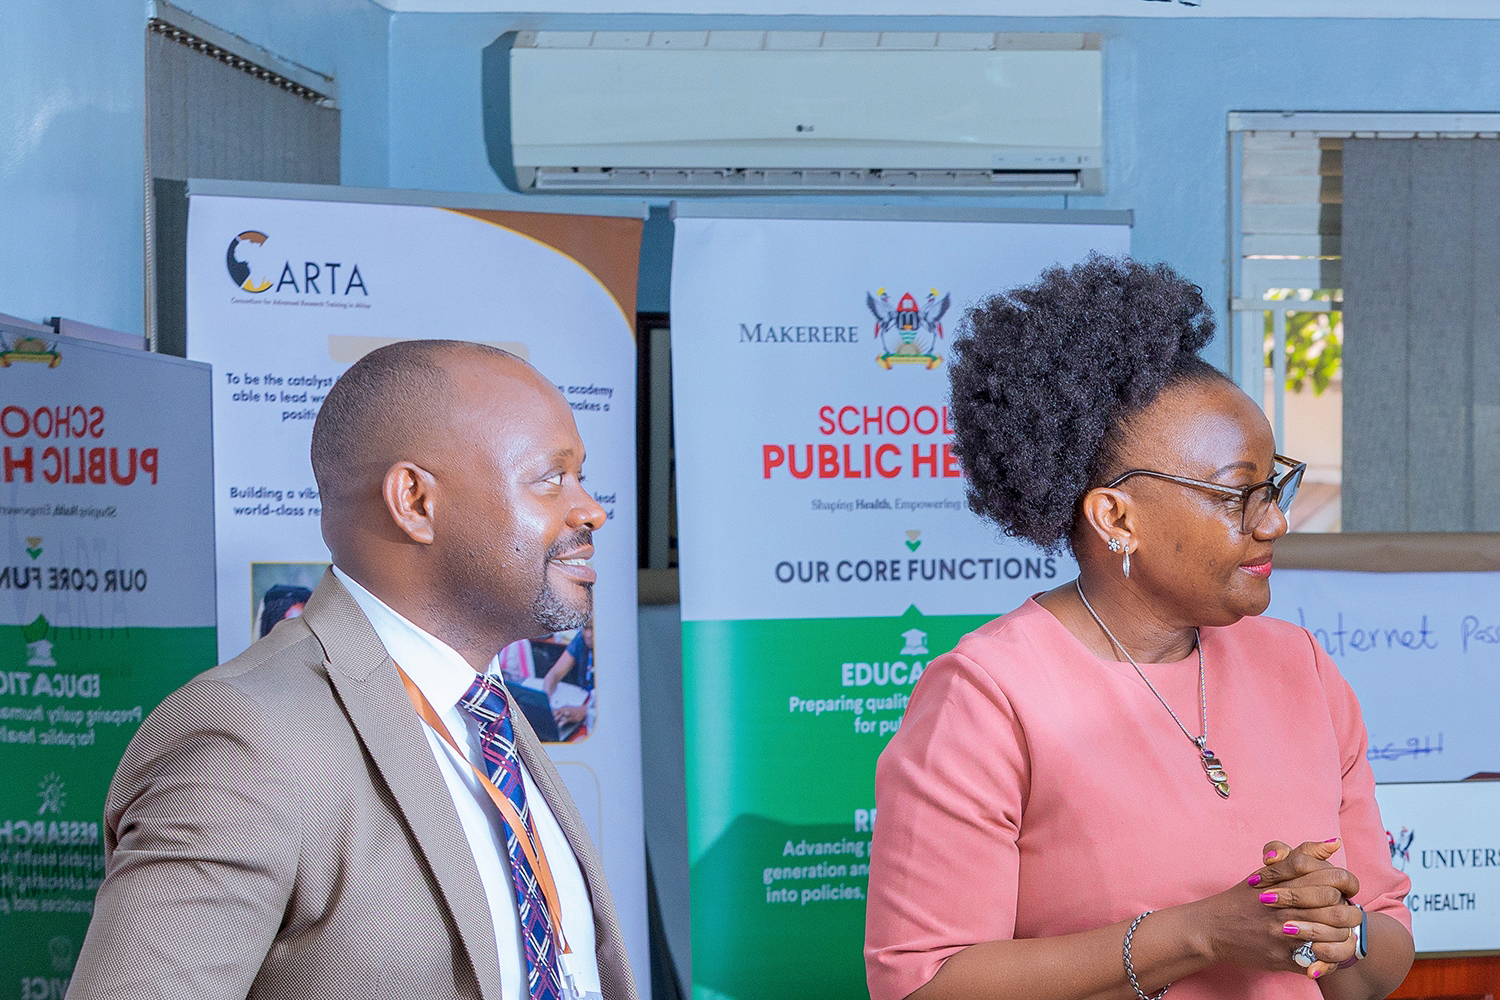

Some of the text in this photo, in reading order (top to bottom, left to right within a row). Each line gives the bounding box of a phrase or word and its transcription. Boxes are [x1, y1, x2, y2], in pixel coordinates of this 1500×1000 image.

[226, 373, 240, 385] To
[244, 373, 260, 385] be
[264, 374, 283, 386] the
[287, 374, 332, 389] catalyst
[568, 383, 614, 399] academy
[232, 390, 260, 402] able
[265, 391, 276, 402] to
[280, 391, 307, 402] lead
[819, 406, 955, 435] SCHOOL
[763, 443, 968, 479] PUBLIC HE
[230, 487, 283, 501] Building
[287, 490, 294, 498] a
[233, 504, 305, 516] world-class
[811, 498, 854, 513] Shaping
[895, 498, 961, 512] Empowering
[775, 556, 1057, 584] OUR CORE FUNCTIONS
[842, 661, 931, 686] EDUCA
[789, 693, 909, 715] Preparing qualit
[854, 716, 876, 733] for
[782, 838, 864, 858] Advancing
[763, 861, 870, 884] generation an
[766, 886, 798, 903] into
[1424, 893, 1475, 912] HEALTH
